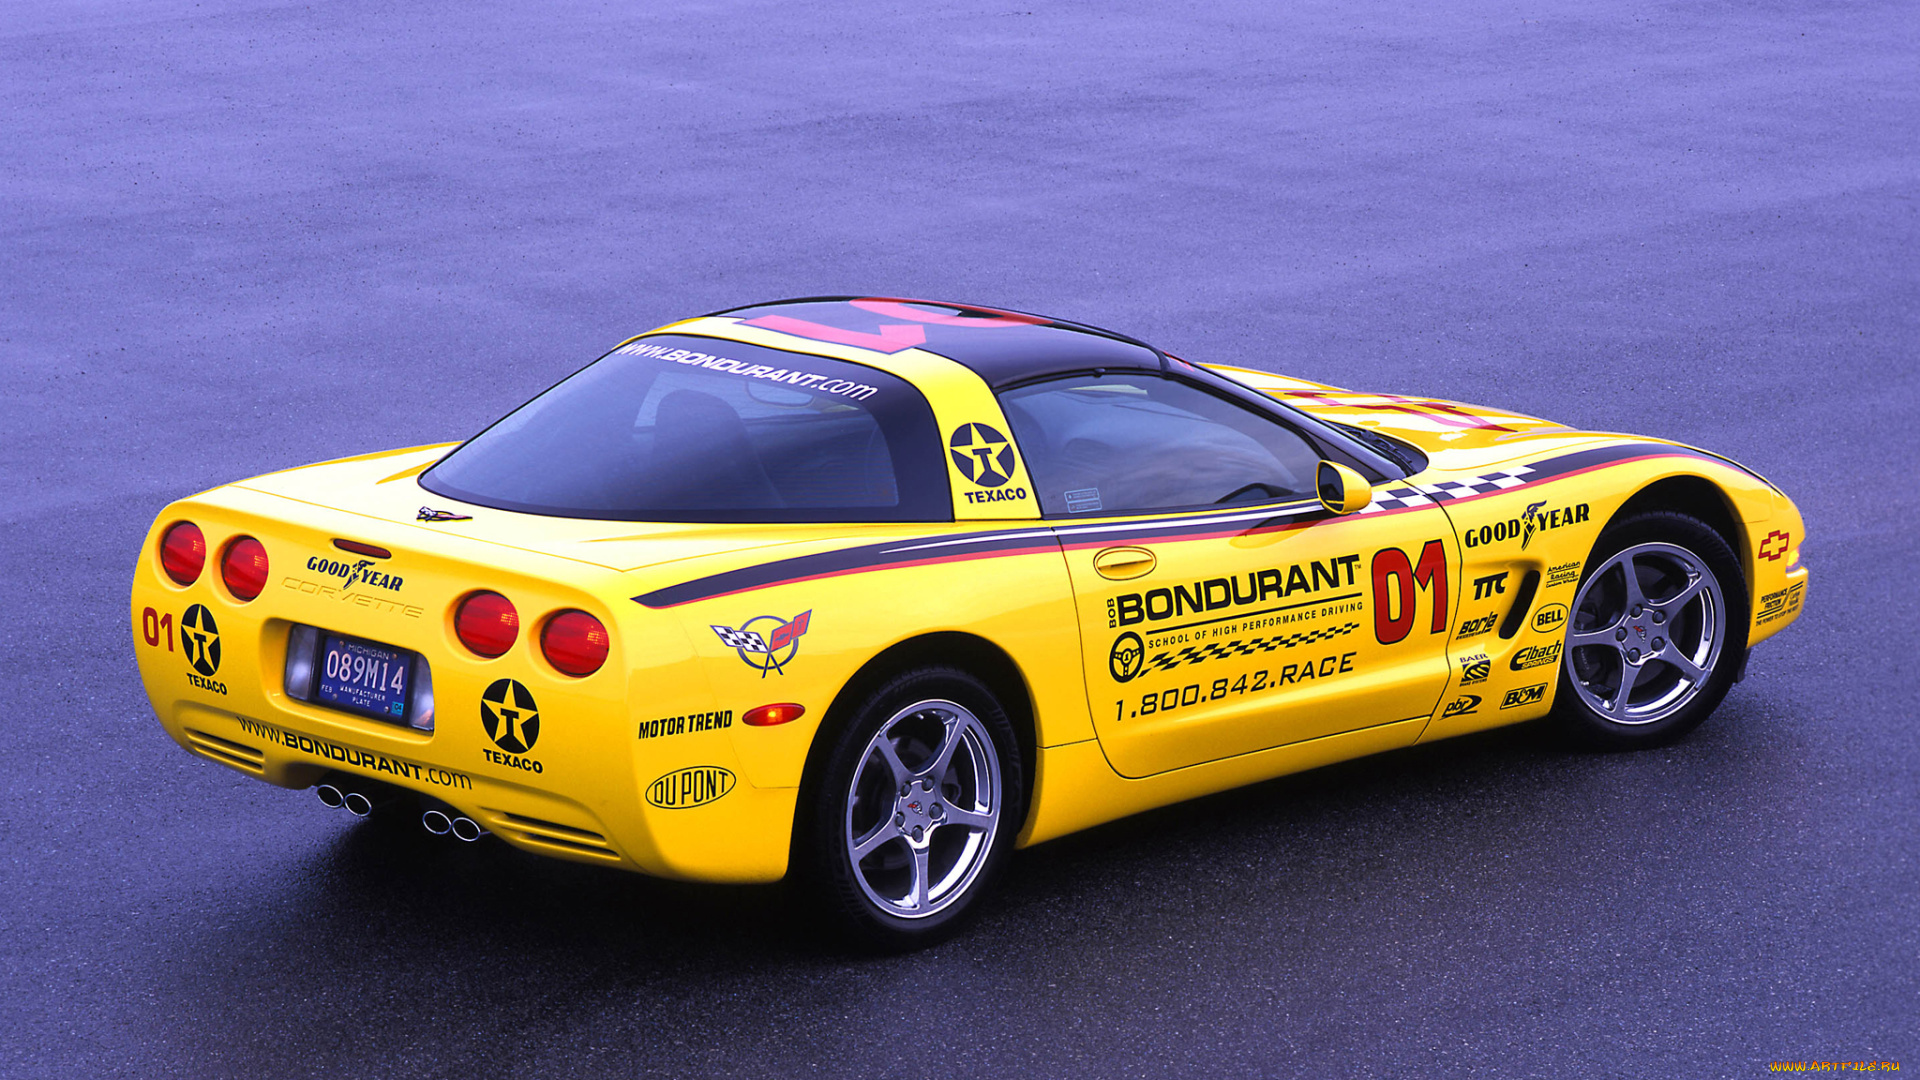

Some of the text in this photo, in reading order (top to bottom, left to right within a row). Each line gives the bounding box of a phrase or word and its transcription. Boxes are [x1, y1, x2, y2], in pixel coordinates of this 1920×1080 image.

[614, 343, 879, 401] www.BONDURANT.com
[963, 487, 1027, 505] TEXACO
[281, 577, 424, 618] CORVETTE
[1117, 554, 1360, 627] BONDURANT
[1370, 538, 1449, 646] 01
[1106, 597, 1117, 628] BOB
[1148, 601, 1364, 649] SCHOOL OF HIGH PERFORMANCE DRIVING
[1537, 609, 1564, 626] BELL
[142, 607, 174, 653] 01
[348, 644, 390, 660] MICHIGAN
[1459, 653, 1488, 663] BAER
[1510, 639, 1562, 671] Eibach
[186, 673, 228, 696] TEXACO
[326, 650, 404, 695] 089M14
[1115, 651, 1358, 722] 1.800.842.RACE
[321, 684, 333, 693] FEB
[340, 686, 386, 702] MANUFACTURER
[352, 697, 371, 707] PLATE
[1503, 685, 1546, 706] B&M
[1442, 698, 1470, 718] pbr
[638, 710, 733, 739] MOTOR TREND
[236, 716, 473, 791] www.BONDURANT.com
[482, 748, 543, 774] TEXACO
